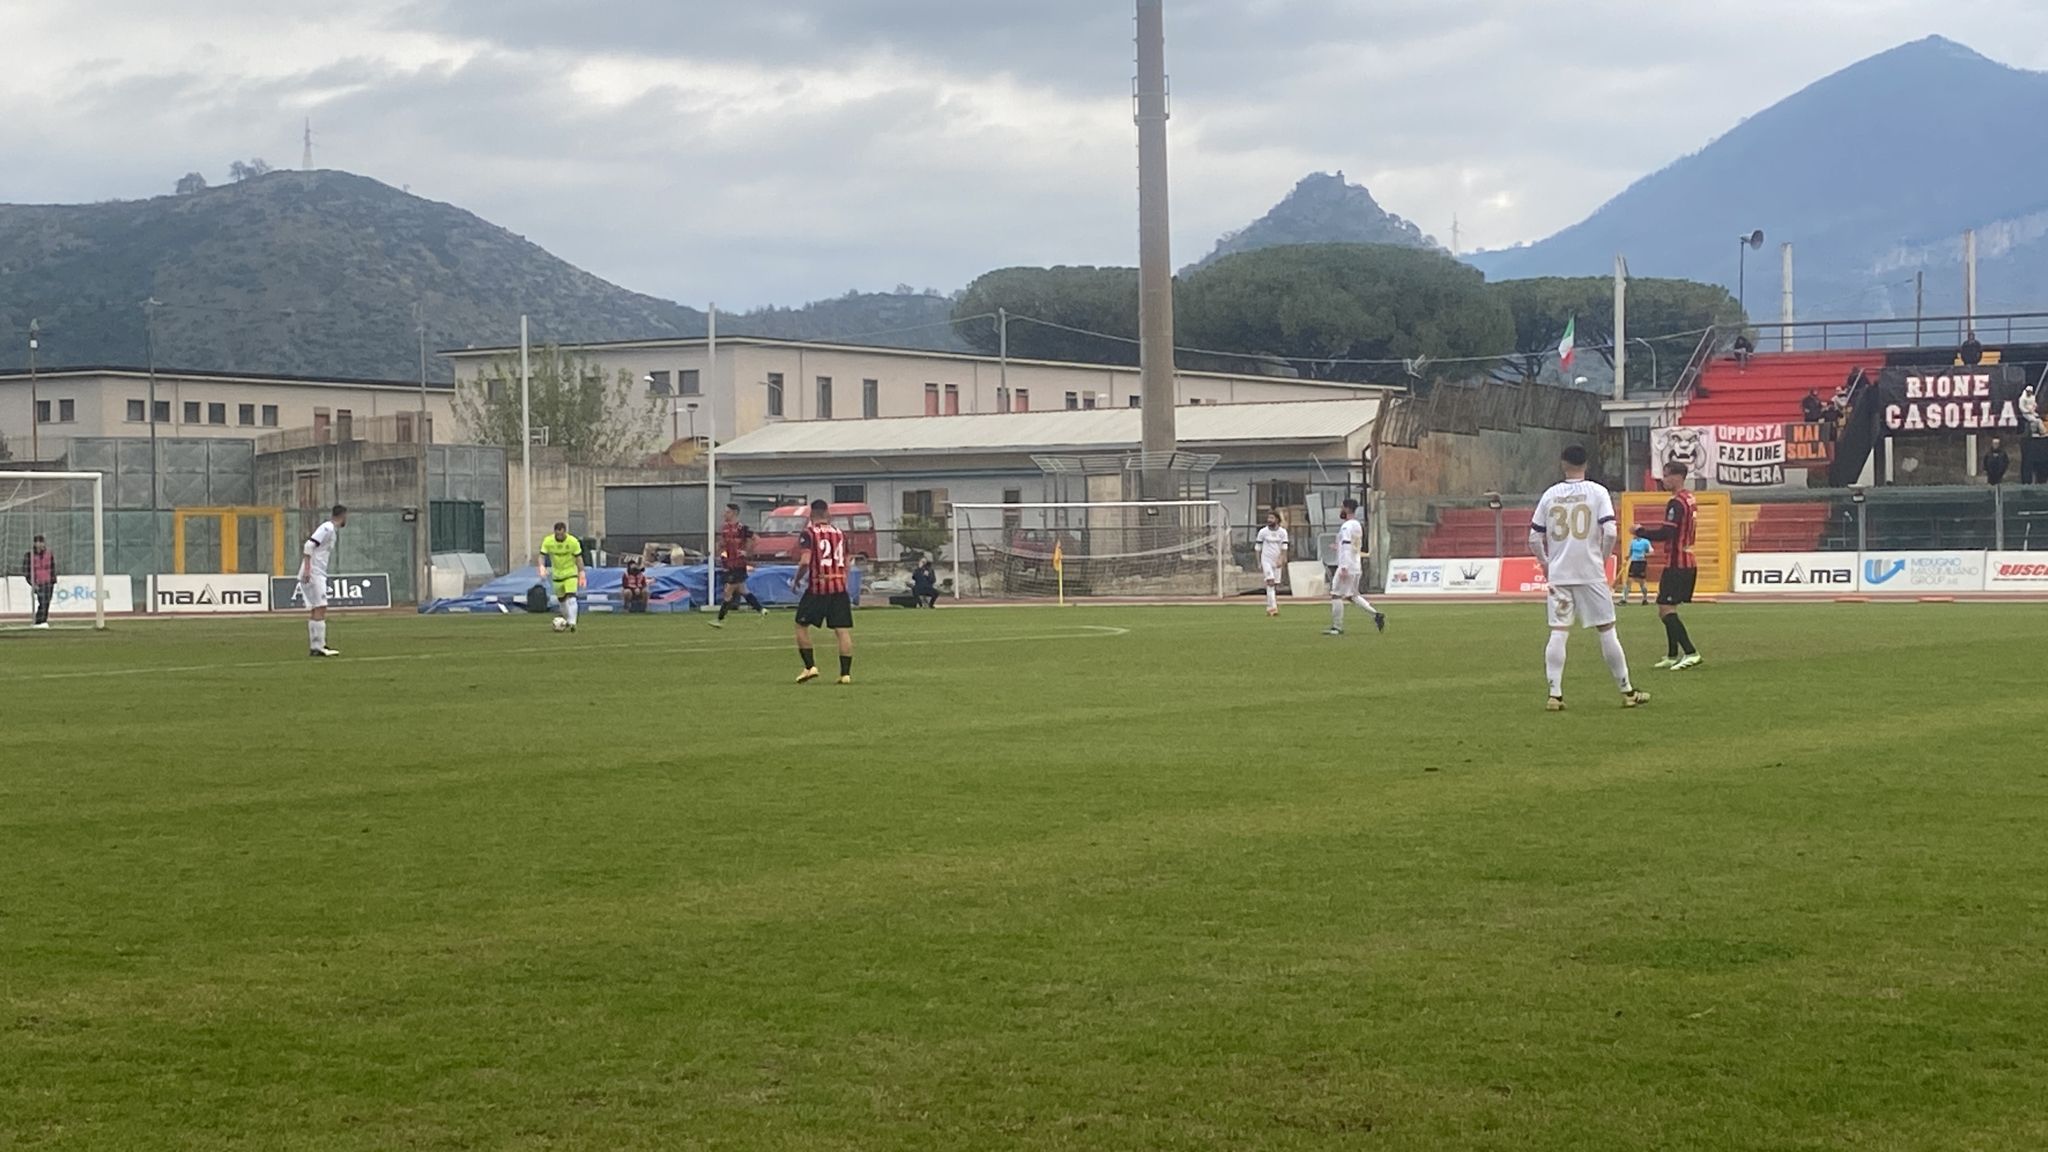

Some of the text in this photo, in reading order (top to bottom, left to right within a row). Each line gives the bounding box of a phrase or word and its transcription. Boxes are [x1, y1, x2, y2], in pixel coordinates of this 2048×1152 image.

[1906, 374, 1990, 398] RIONE
[1885, 401, 2019, 429] CASOLLA
[1718, 424, 1782, 441] OPPOSTA
[1718, 444, 1783, 462] FAZIONE
[1787, 441, 1828, 460] SOLA
[1717, 464, 1784, 484] NOCERA
[1549, 504, 1591, 541] 30
[820, 539, 845, 568] 24
